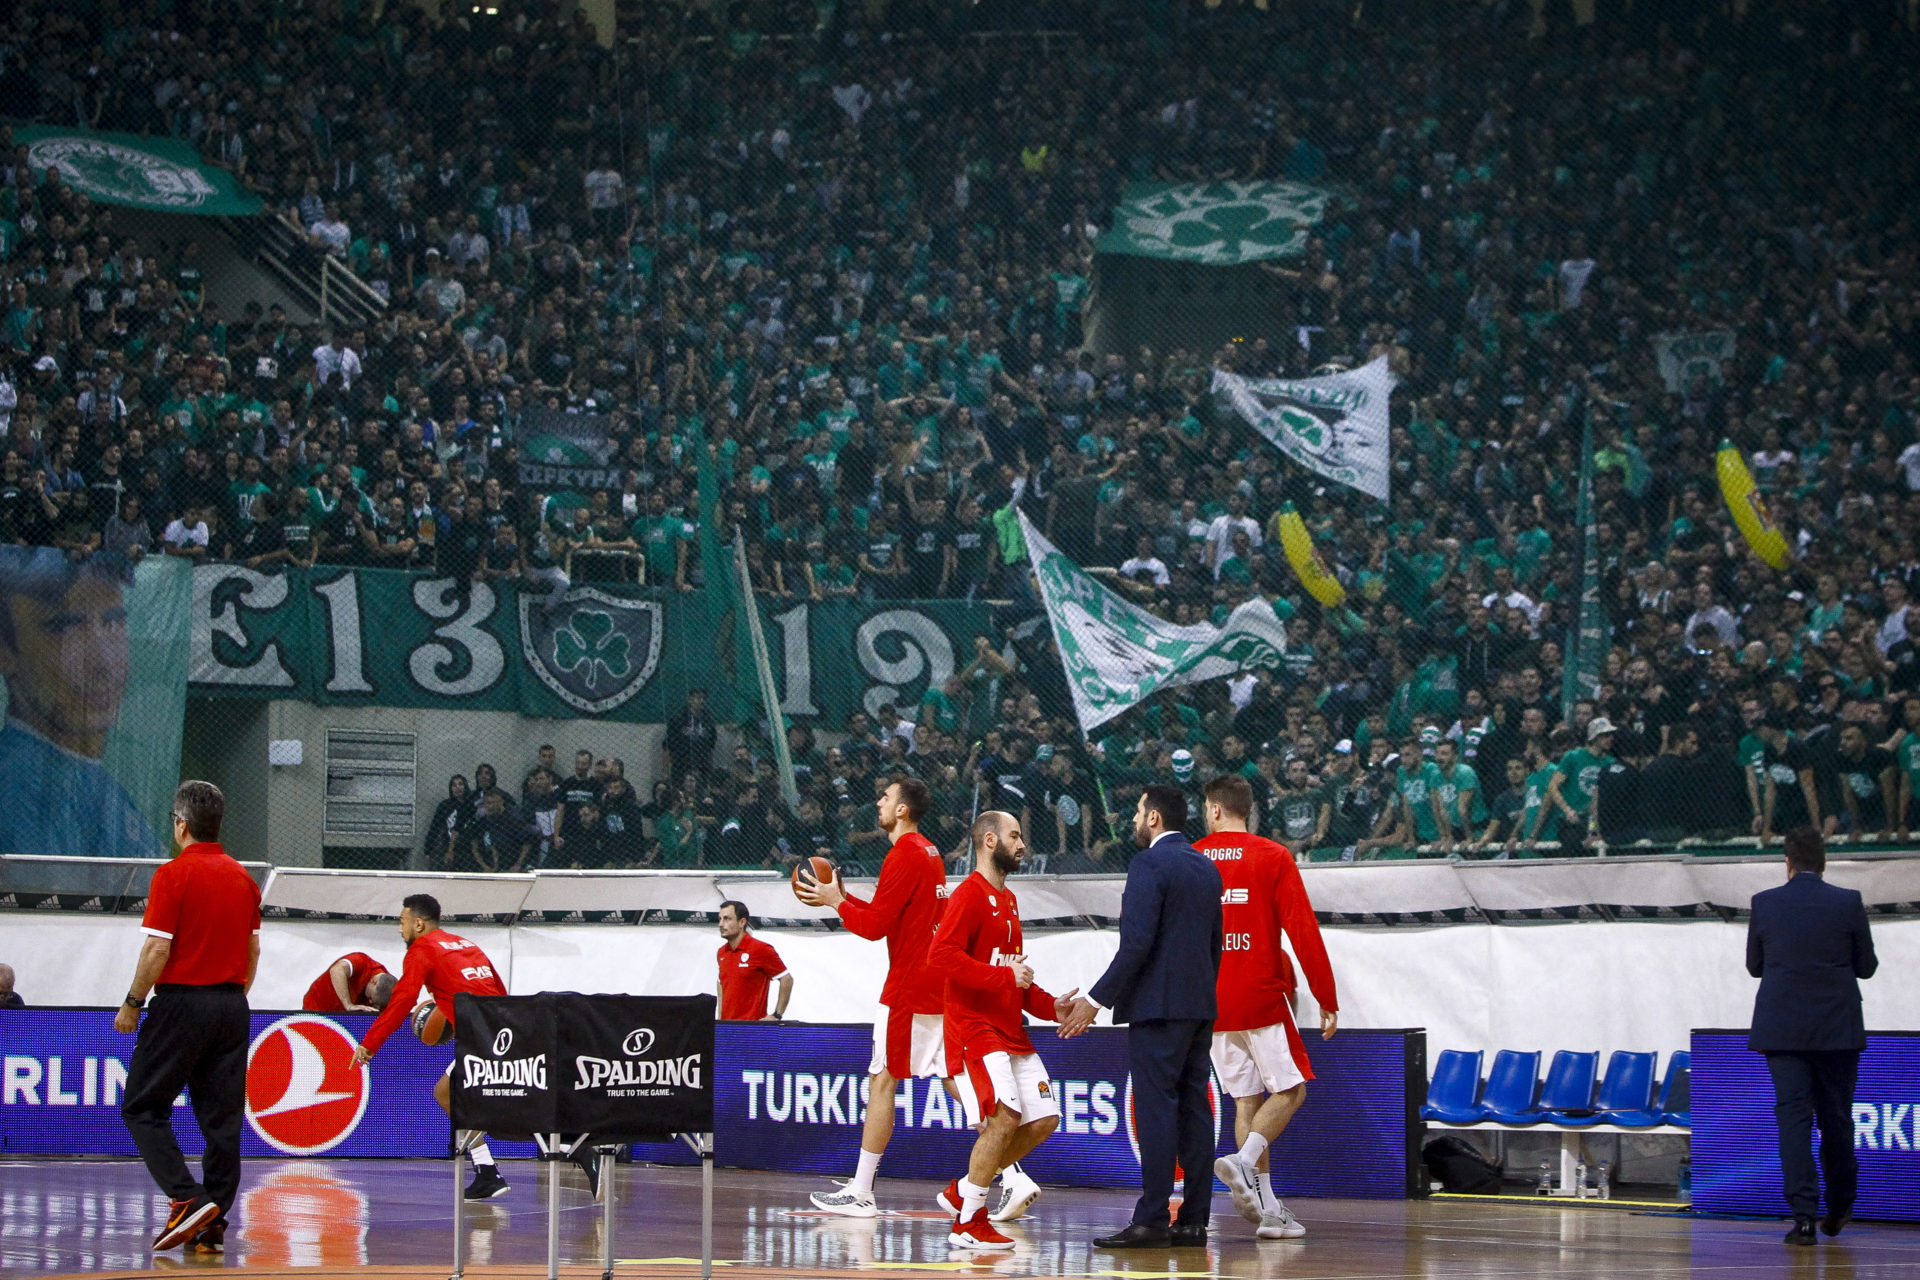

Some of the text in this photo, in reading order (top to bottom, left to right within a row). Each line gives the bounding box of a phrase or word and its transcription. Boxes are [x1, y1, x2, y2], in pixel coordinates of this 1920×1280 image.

[1203, 848, 1243, 860] BOGRIS
[463, 1053, 547, 1090] SPALDING
[574, 1053, 702, 1091] SPALDING
[606, 1088, 670, 1097] TRUE TO THE GAME
